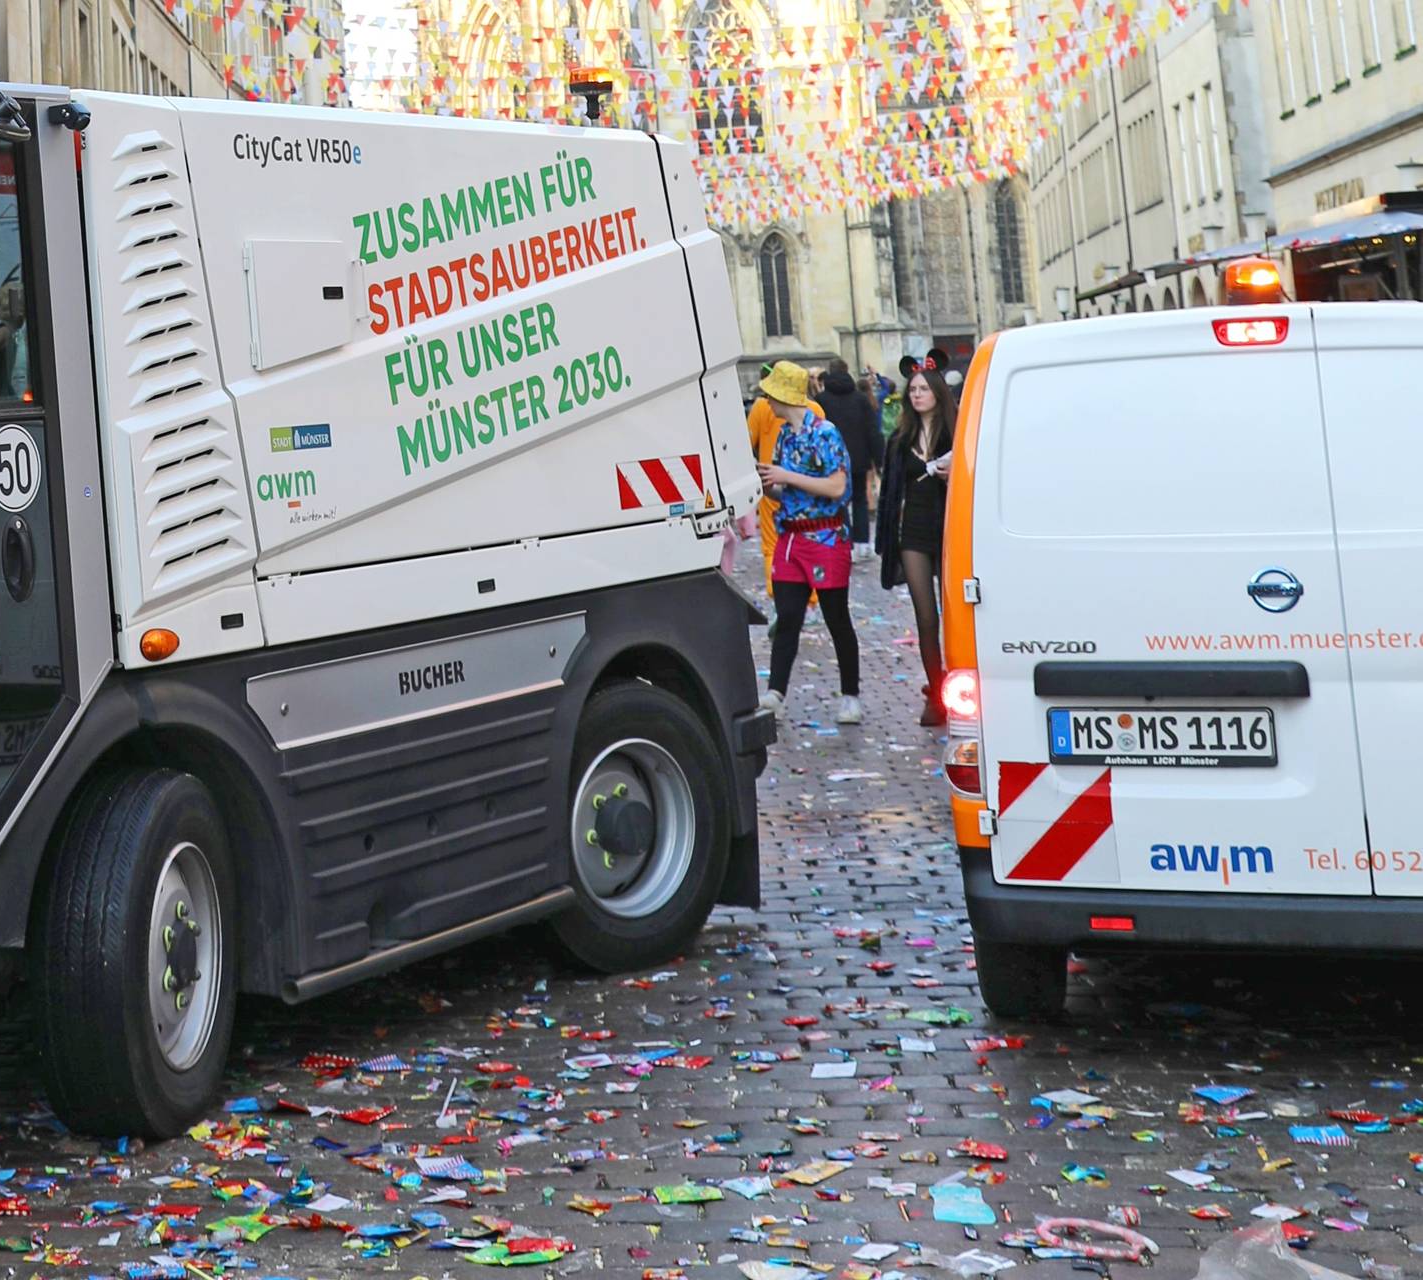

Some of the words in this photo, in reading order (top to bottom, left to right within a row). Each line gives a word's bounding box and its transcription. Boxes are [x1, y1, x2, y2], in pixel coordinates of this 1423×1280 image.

[233, 133, 303, 168] CityCat
[307, 138, 362, 165] VR50e
[352, 171, 537, 265] ZUSAMMEN
[539, 149, 597, 213] FÜR
[367, 207, 647, 336] STADTSAUBERKEIT.
[384, 333, 454, 406] FÜR
[456, 302, 560, 379] UNSER
[396, 398, 551, 477] MÜNSTER
[552, 345, 632, 414] 2030.
[272, 436, 292, 449] STADT
[301, 432, 330, 446] MÜNSTER
[257, 470, 316, 501] awm
[1002, 640, 1097, 655] e-NV200
[399, 660, 466, 696] BUCHER
[1058, 736, 1067, 748] D
[1073, 716, 1114, 750] MS
[1137, 716, 1179, 750] MS
[1187, 716, 1268, 751] 1116
[1104, 756, 1148, 766] Autohaus
[1181, 756, 1219, 767] Münster
[1303, 848, 1347, 871] Tel.
